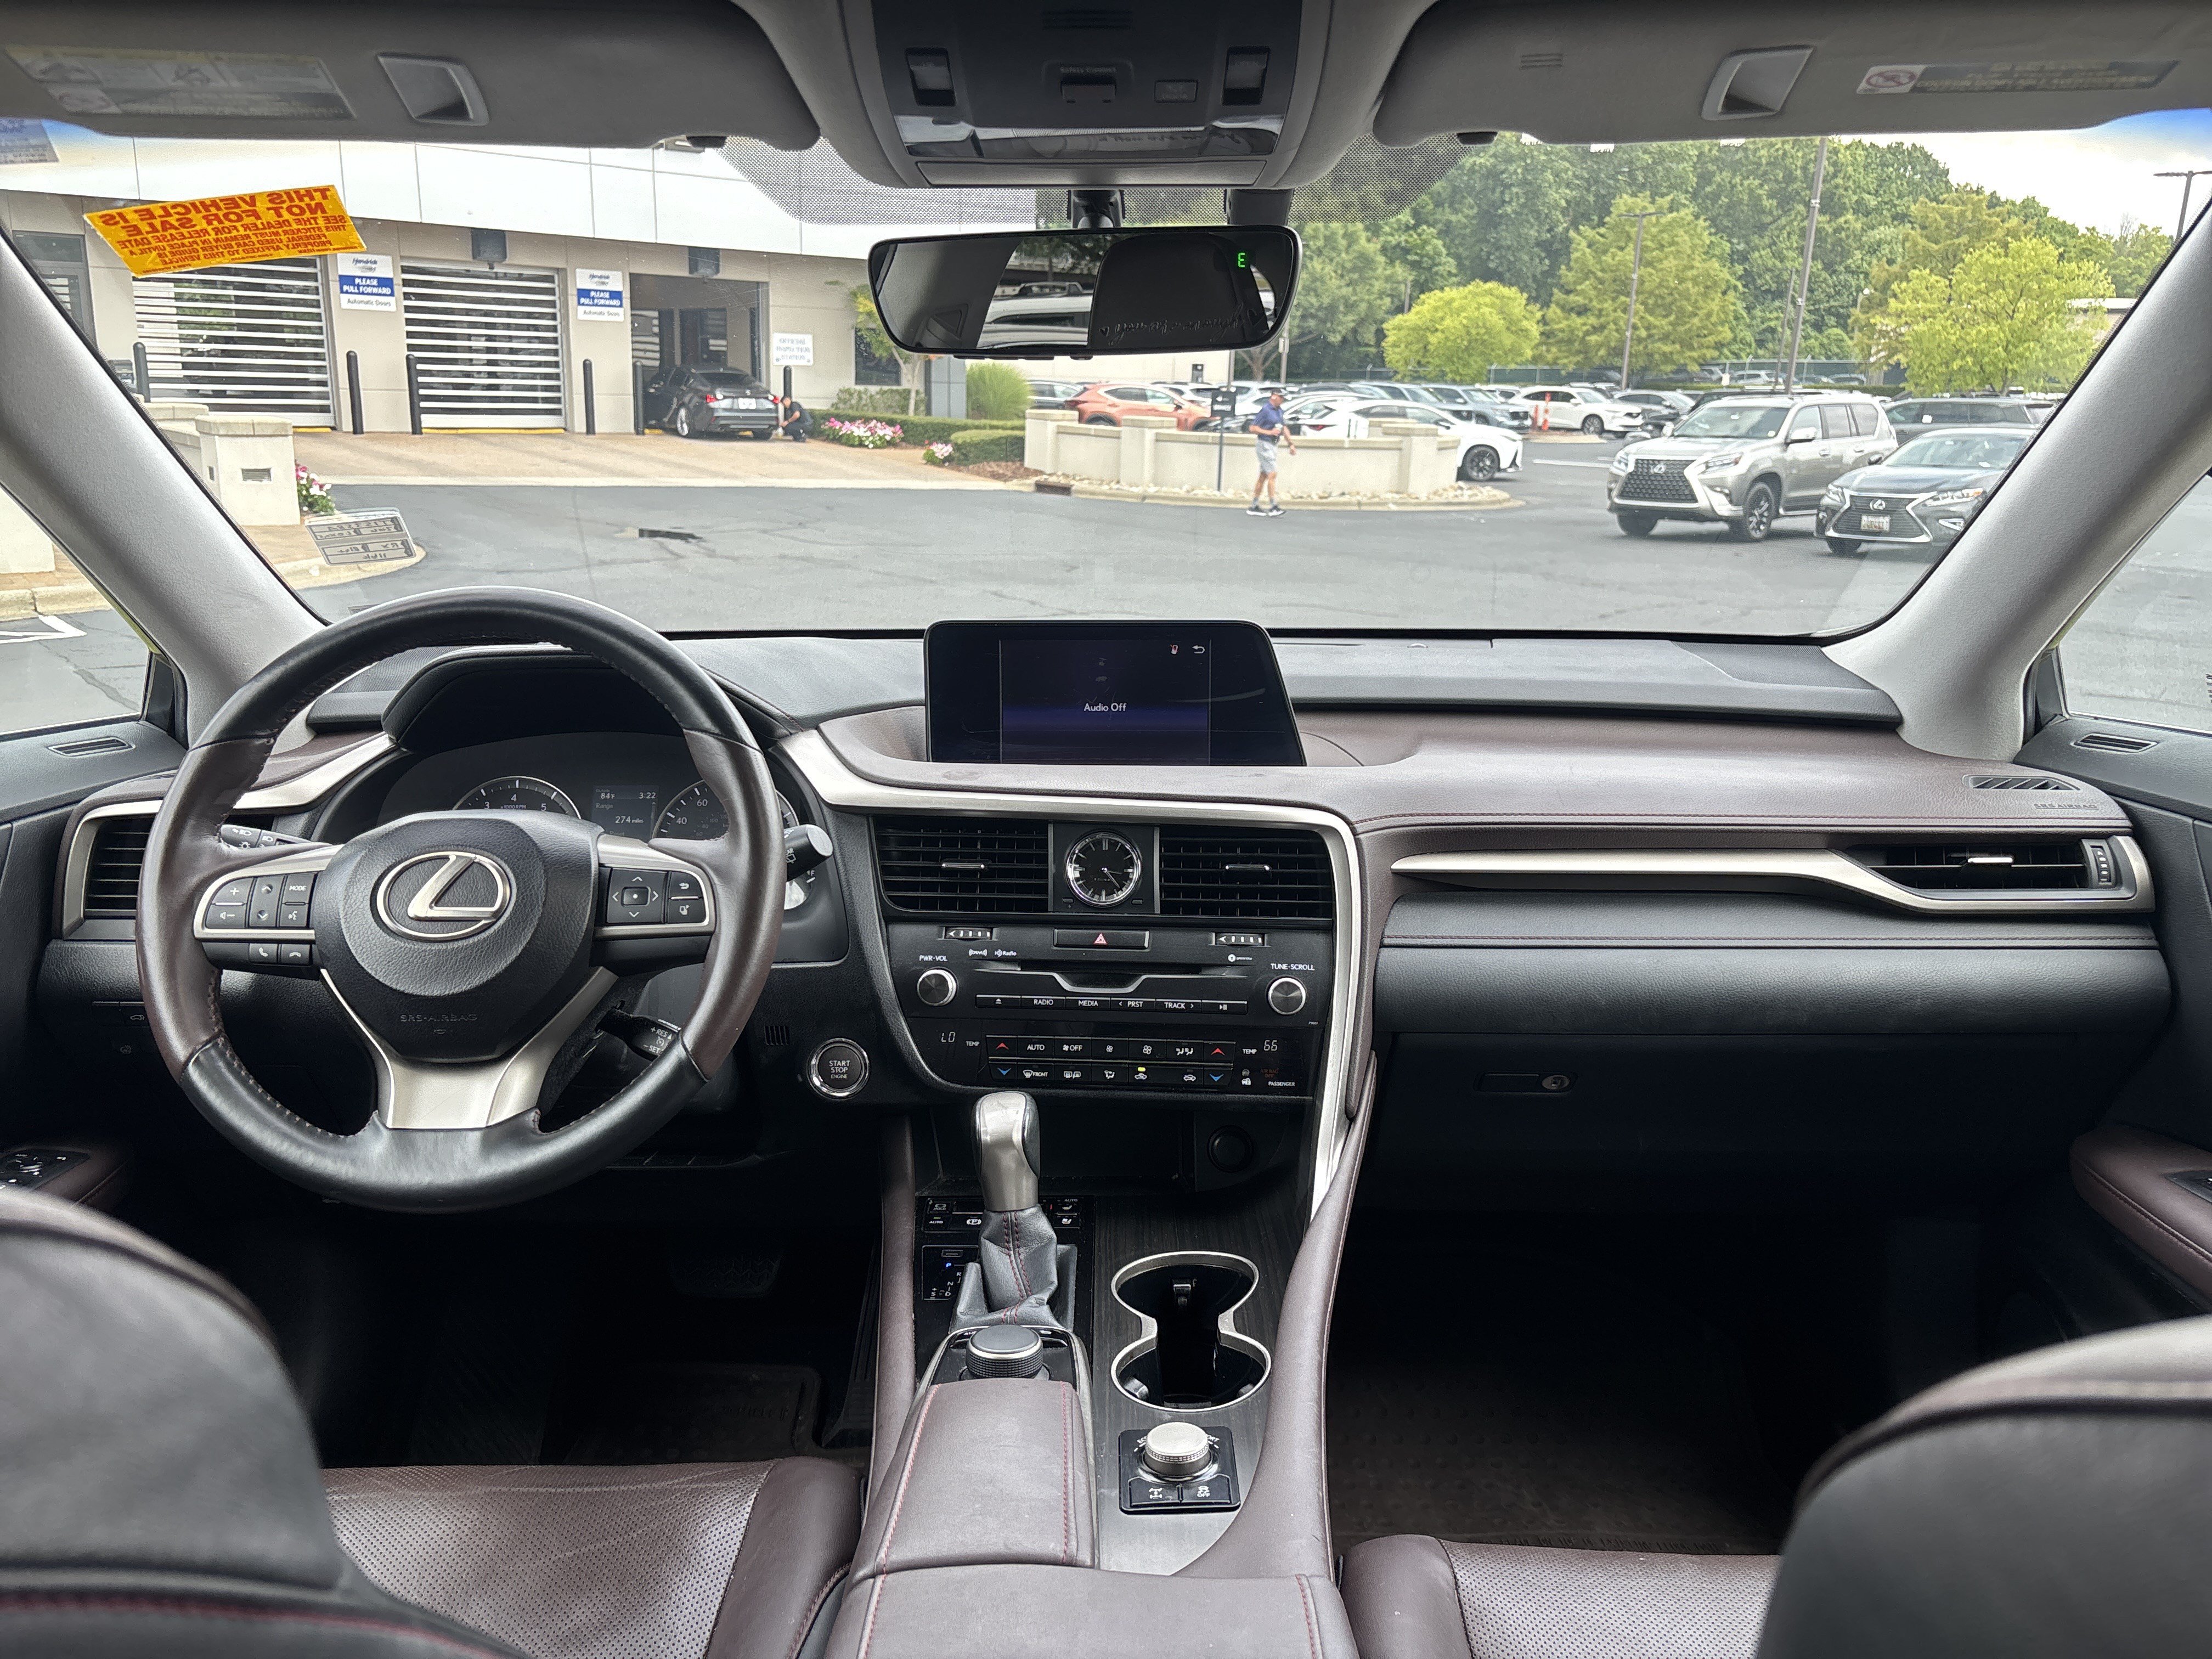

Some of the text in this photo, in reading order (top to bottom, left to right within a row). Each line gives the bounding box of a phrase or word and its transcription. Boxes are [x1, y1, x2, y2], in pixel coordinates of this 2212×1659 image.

[1237, 252, 1247, 269] E
[360, 286, 391, 295] FORWARD
[1084, 703, 1127, 712] Audio Off
[1263, 1040, 1277, 1051] 66
